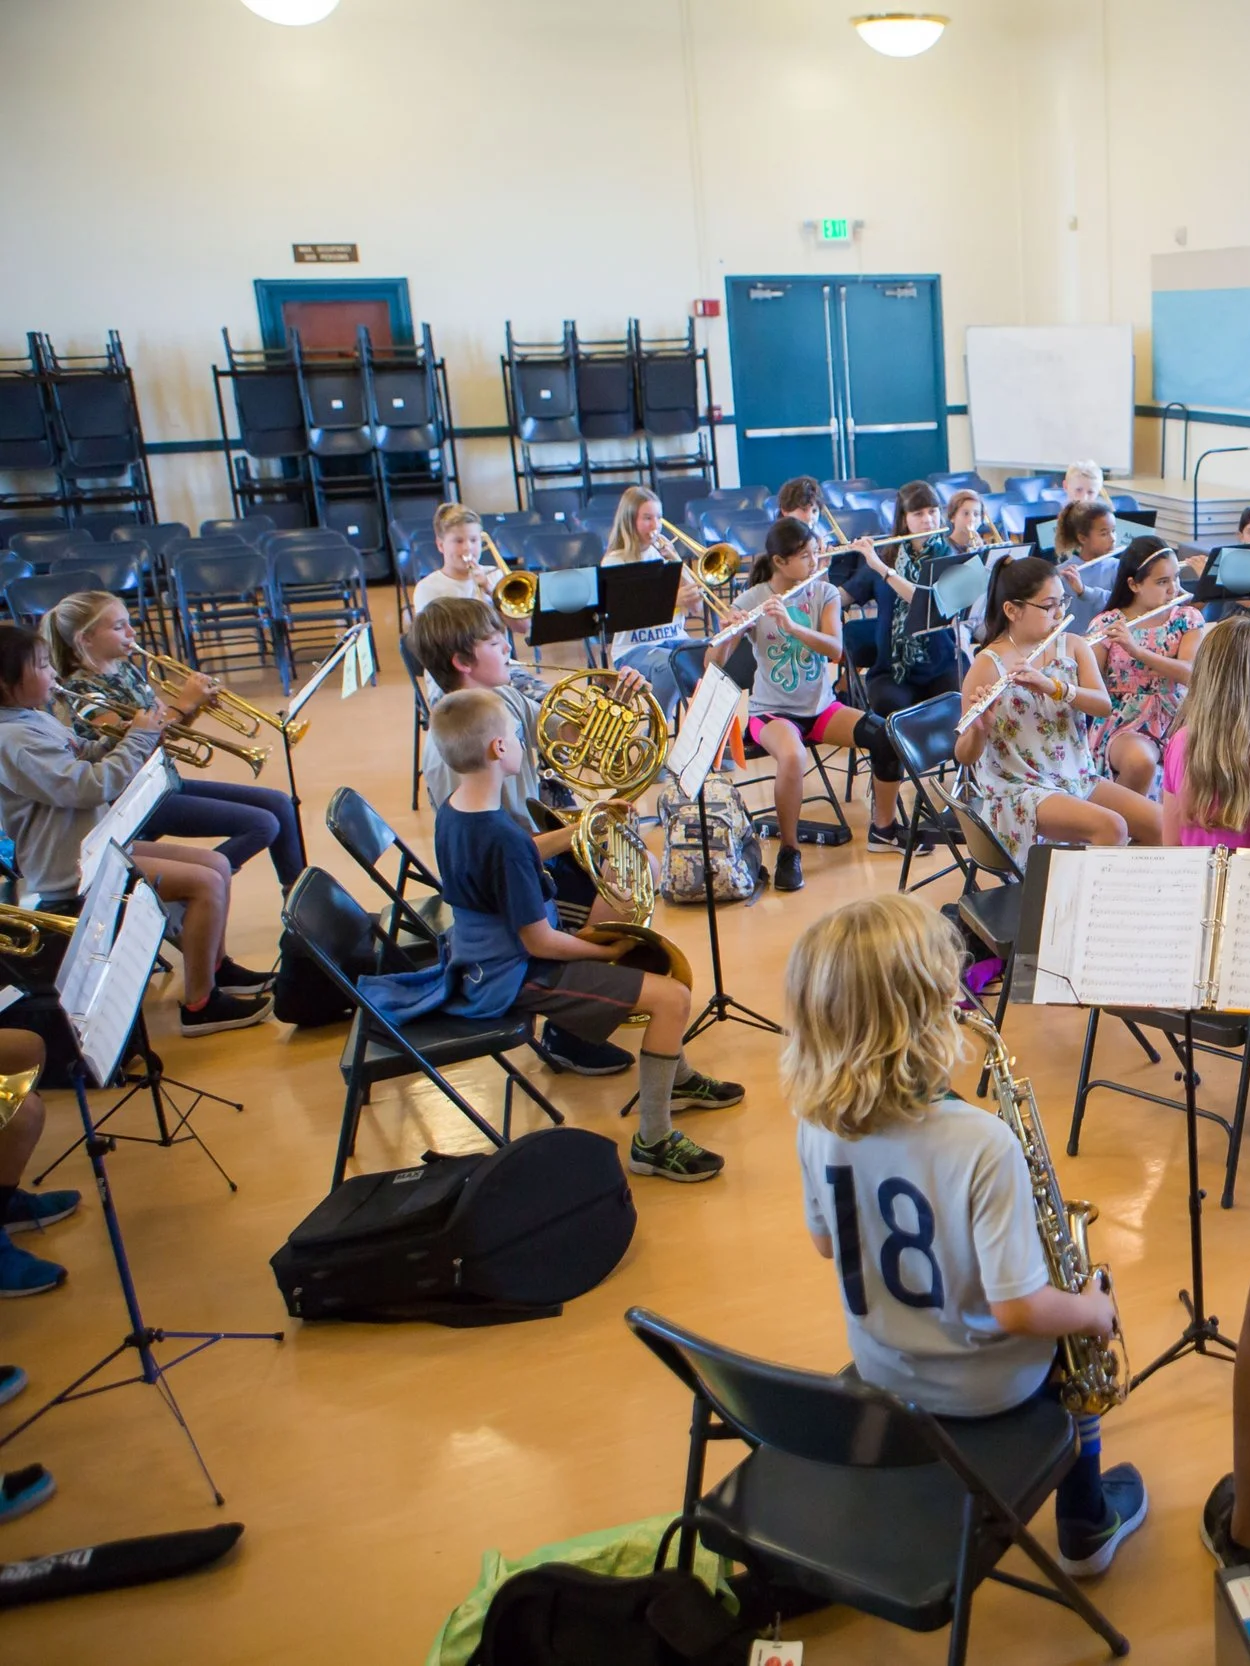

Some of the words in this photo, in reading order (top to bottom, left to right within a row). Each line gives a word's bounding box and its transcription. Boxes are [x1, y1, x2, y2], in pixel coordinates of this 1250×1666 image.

[823, 219, 848, 238] EXIT
[631, 623, 682, 642] ACADEMY
[826, 1165, 945, 1316] 18
